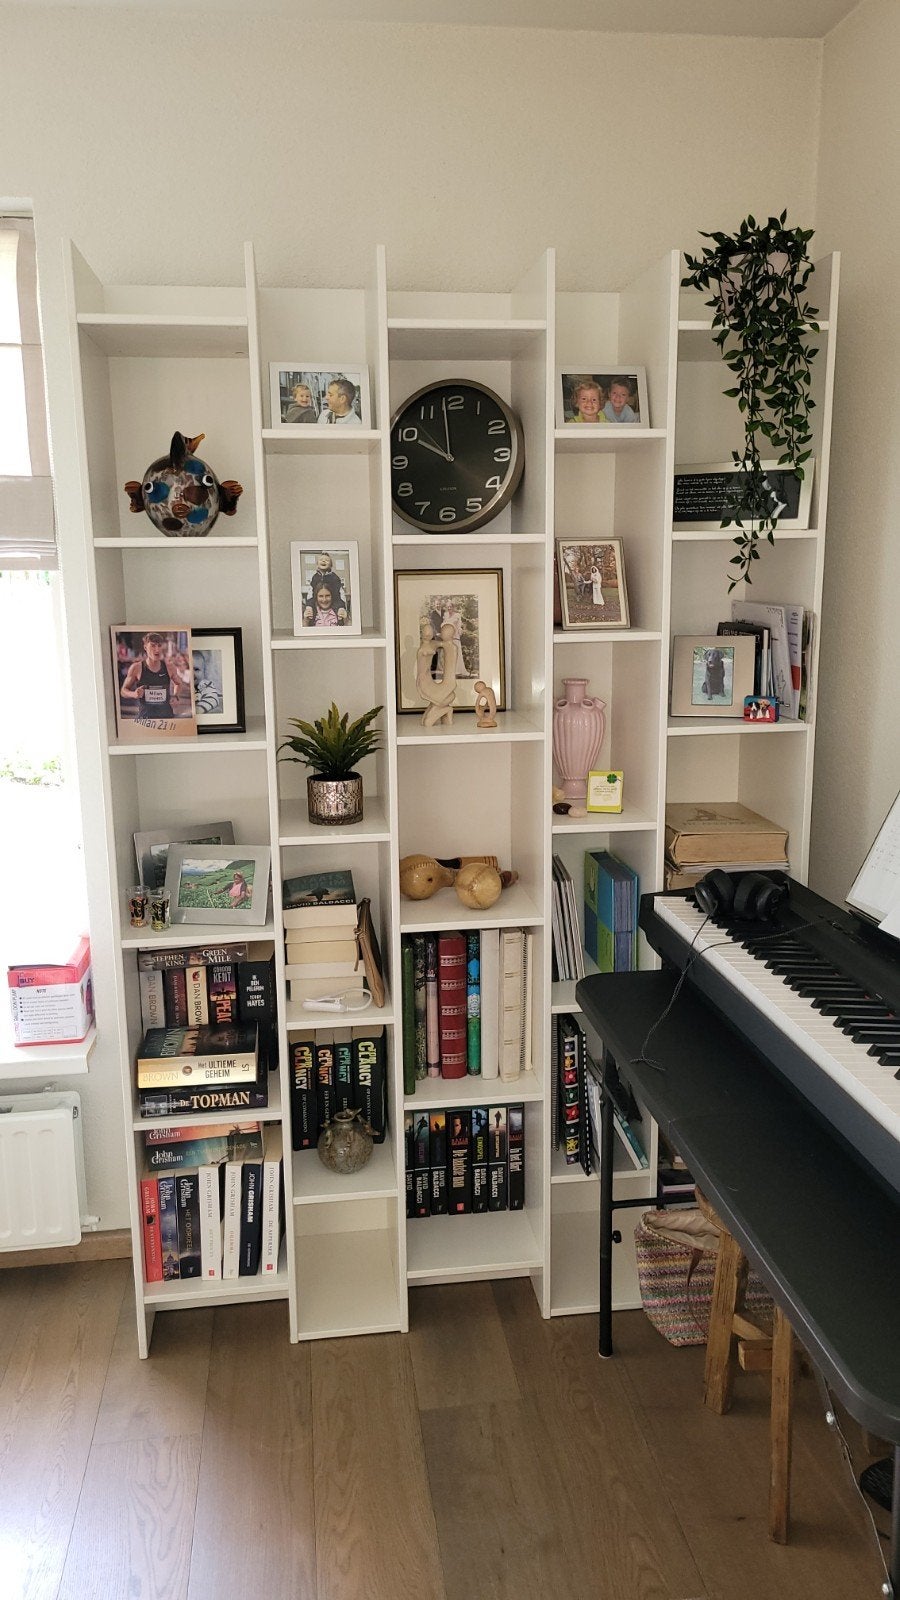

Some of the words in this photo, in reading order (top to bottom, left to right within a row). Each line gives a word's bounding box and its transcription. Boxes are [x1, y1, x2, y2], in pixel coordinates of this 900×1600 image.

[421, 405, 434, 420] 11
[477, 401, 481, 415] 1
[398, 427, 418, 442] 10
[488, 420, 506, 435] 2
[392, 455, 409, 470] 9
[493, 448, 511, 462] 3
[397, 482, 414, 497] 8
[485, 476, 502, 490] 4
[415, 501, 431, 515] 7
[465, 497, 483, 512] 5
[439, 507, 457, 522] 6
[286, 901, 311, 909] DAVID
[312, 898, 354, 906] BALDACCI
[151, 953, 184, 963] STEPHEN
[202, 948, 227, 958] GREEN
[208, 955, 232, 964] MILE
[165, 959, 185, 968] KING
[147, 975, 157, 993] DAN
[213, 972, 232, 983] KENT
[193, 982, 201, 1000] DAN
[149, 994, 158, 1025] BROWN
[246, 1000, 265, 1008] HAYES
[194, 1000, 203, 1025] BROW
[160, 1027, 182, 1057] BROWN
[208, 1060, 237, 1070] ULTIEME
[295, 1046, 310, 1090] CLANCY
[318, 1049, 330, 1085] CLANCY
[338, 1047, 350, 1082] CLANCY
[358, 1041, 375, 1087] CLANCY
[142, 1072, 179, 1083] BROWN
[205, 1069, 230, 1079] GEHEIM
[190, 1091, 250, 1109] TOPMAN
[149, 1131, 181, 1141] Grisham
[151, 1154, 184, 1165] Grisham
[155, 1150, 173, 1159] John
[453, 1149, 467, 1157] De
[510, 1153, 522, 1161] het
[453, 1176, 464, 1188] man
[160, 1180, 168, 1210] Grisham
[163, 1183, 173, 1200] John
[179, 1178, 190, 1208] Grisham
[183, 1182, 194, 1199] John
[143, 1186, 152, 1215] GRISHAM
[247, 1189, 255, 1223] GRISHAM
